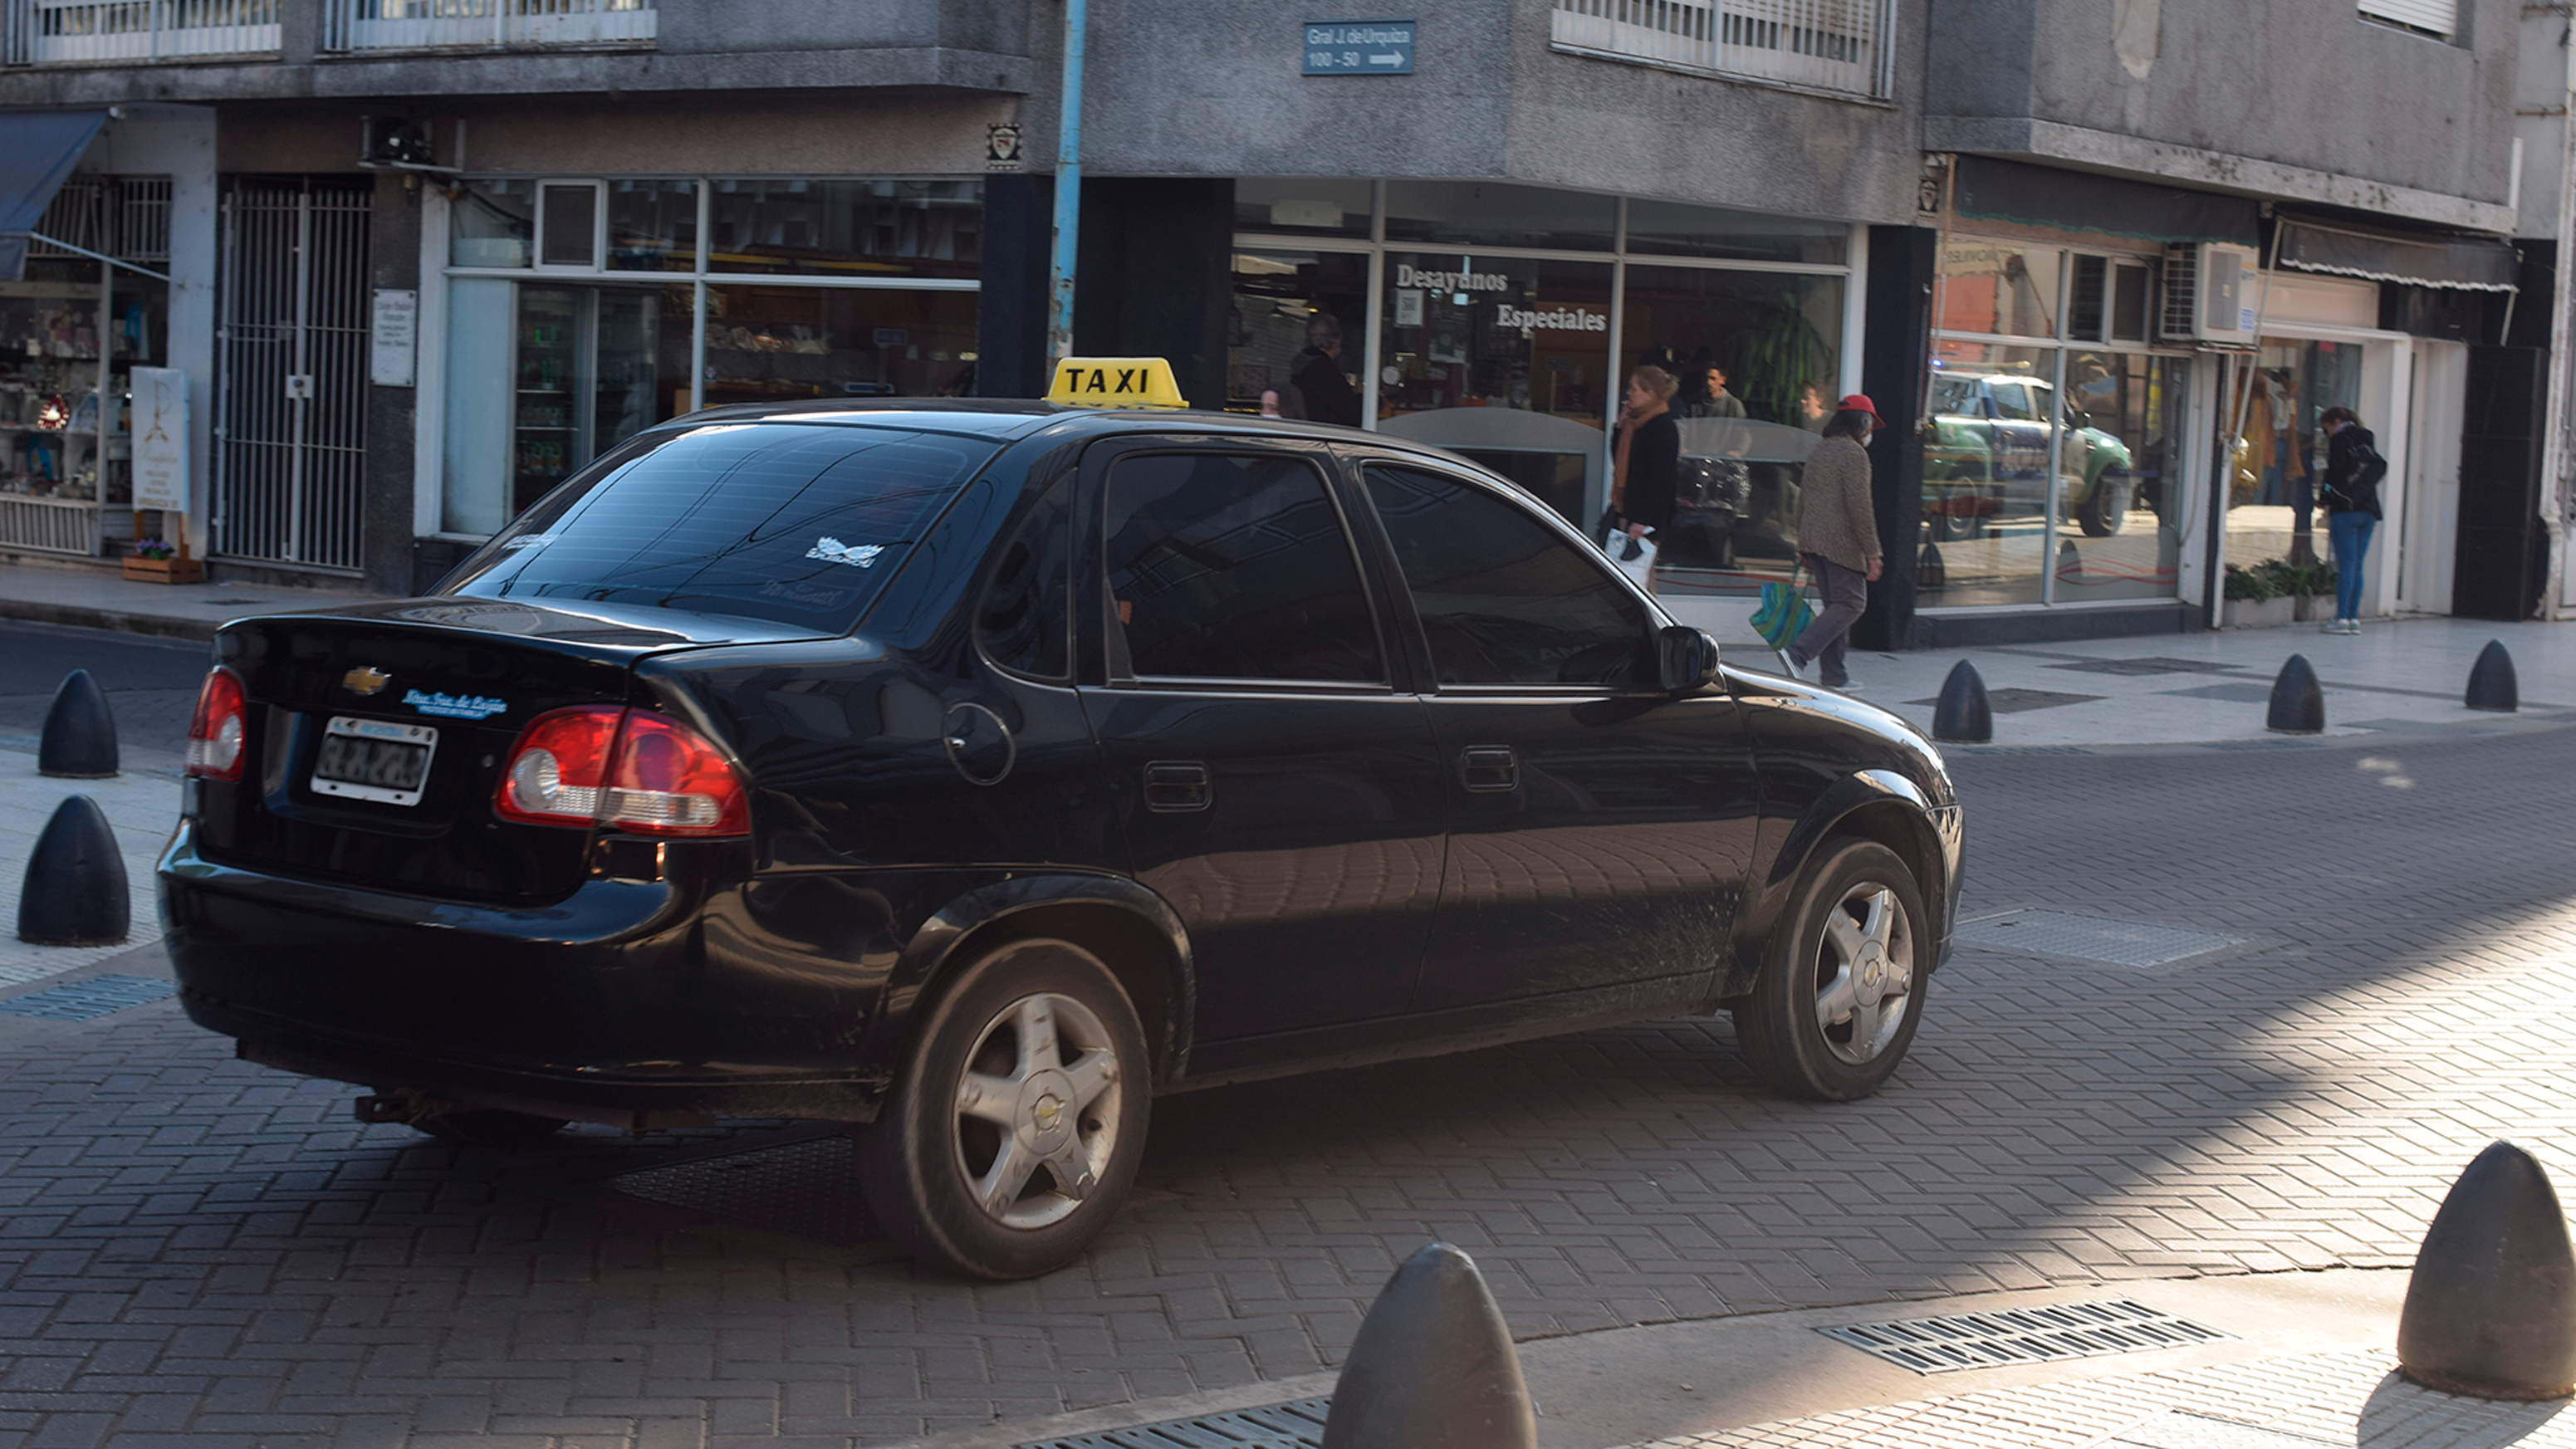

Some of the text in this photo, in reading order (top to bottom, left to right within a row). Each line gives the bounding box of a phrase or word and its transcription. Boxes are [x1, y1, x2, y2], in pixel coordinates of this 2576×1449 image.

[1346, 28, 1363, 44] de
[1363, 27, 1410, 47] Urquiza
[1308, 51, 1334, 67] 100
[1342, 51, 1361, 67] 50
[1396, 264, 1508, 294] Desayunos
[1496, 304, 1608, 332] Especiales
[1065, 369, 1148, 394] TAXI
